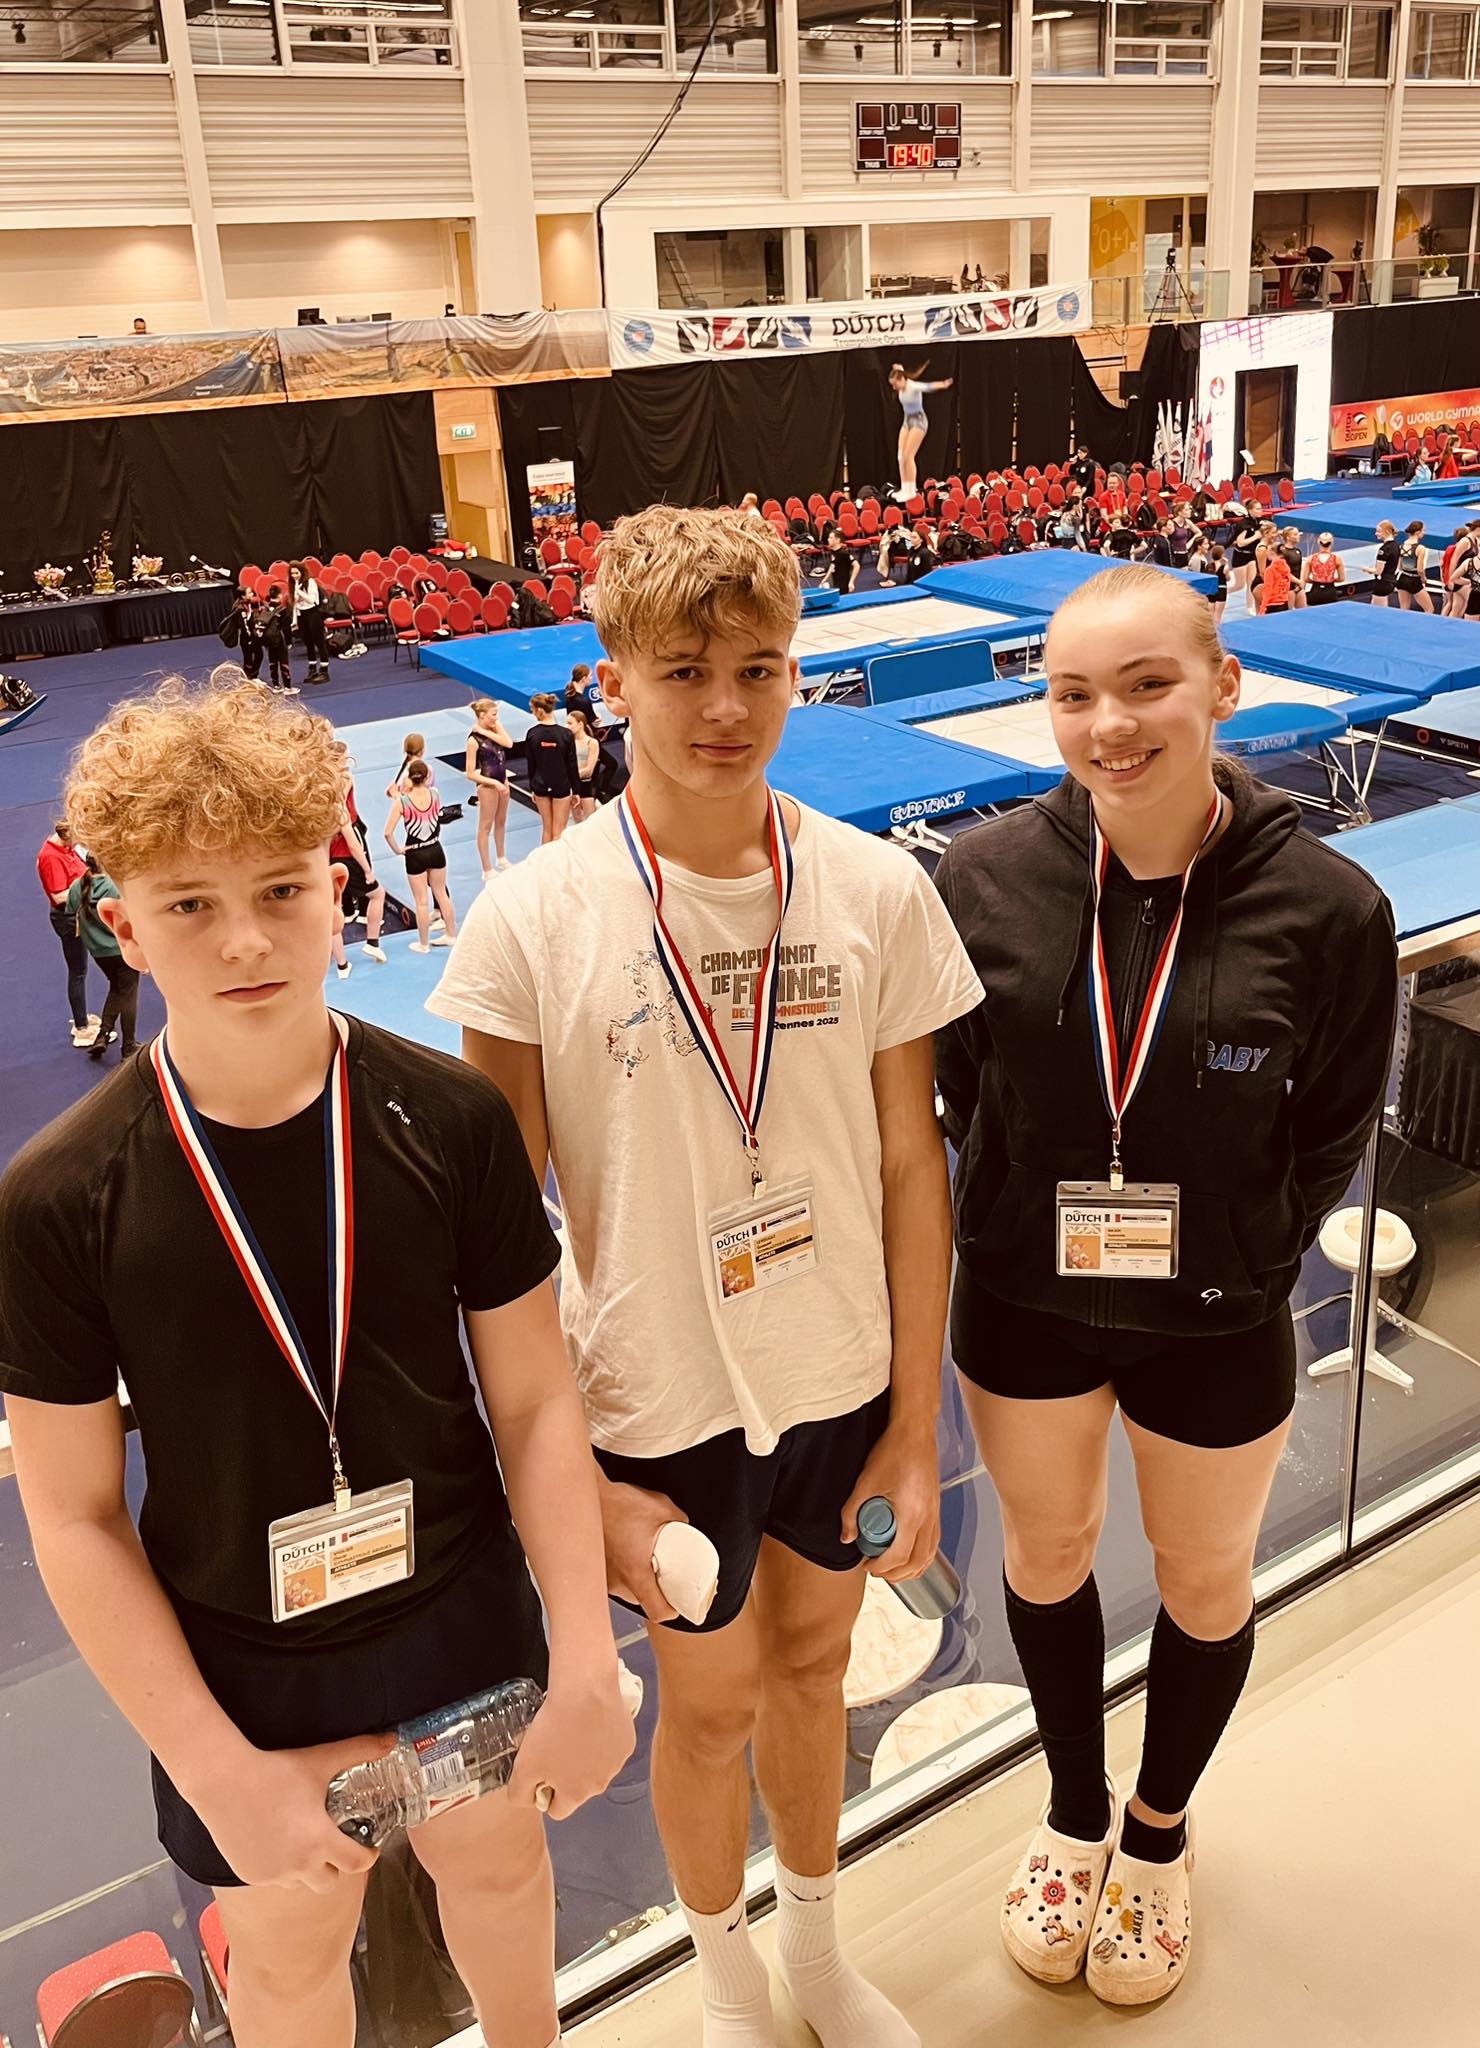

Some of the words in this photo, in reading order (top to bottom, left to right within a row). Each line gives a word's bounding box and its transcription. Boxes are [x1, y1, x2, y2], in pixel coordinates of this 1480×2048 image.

[894, 144, 932, 166] 19:40
[832, 313, 905, 336] DUTCH
[1407, 410, 1444, 425] WORLD
[889, 791, 966, 824] EUROTRAMP
[711, 975, 731, 996] DE
[773, 1020, 815, 1030] Rennes
[816, 1016, 840, 1026] 2025
[1065, 1213, 1102, 1223] DUTCH
[716, 1229, 750, 1249] DUTCH
[282, 1541, 325, 1562] DUTCH
[1132, 1909, 1145, 1936] QUEEN
